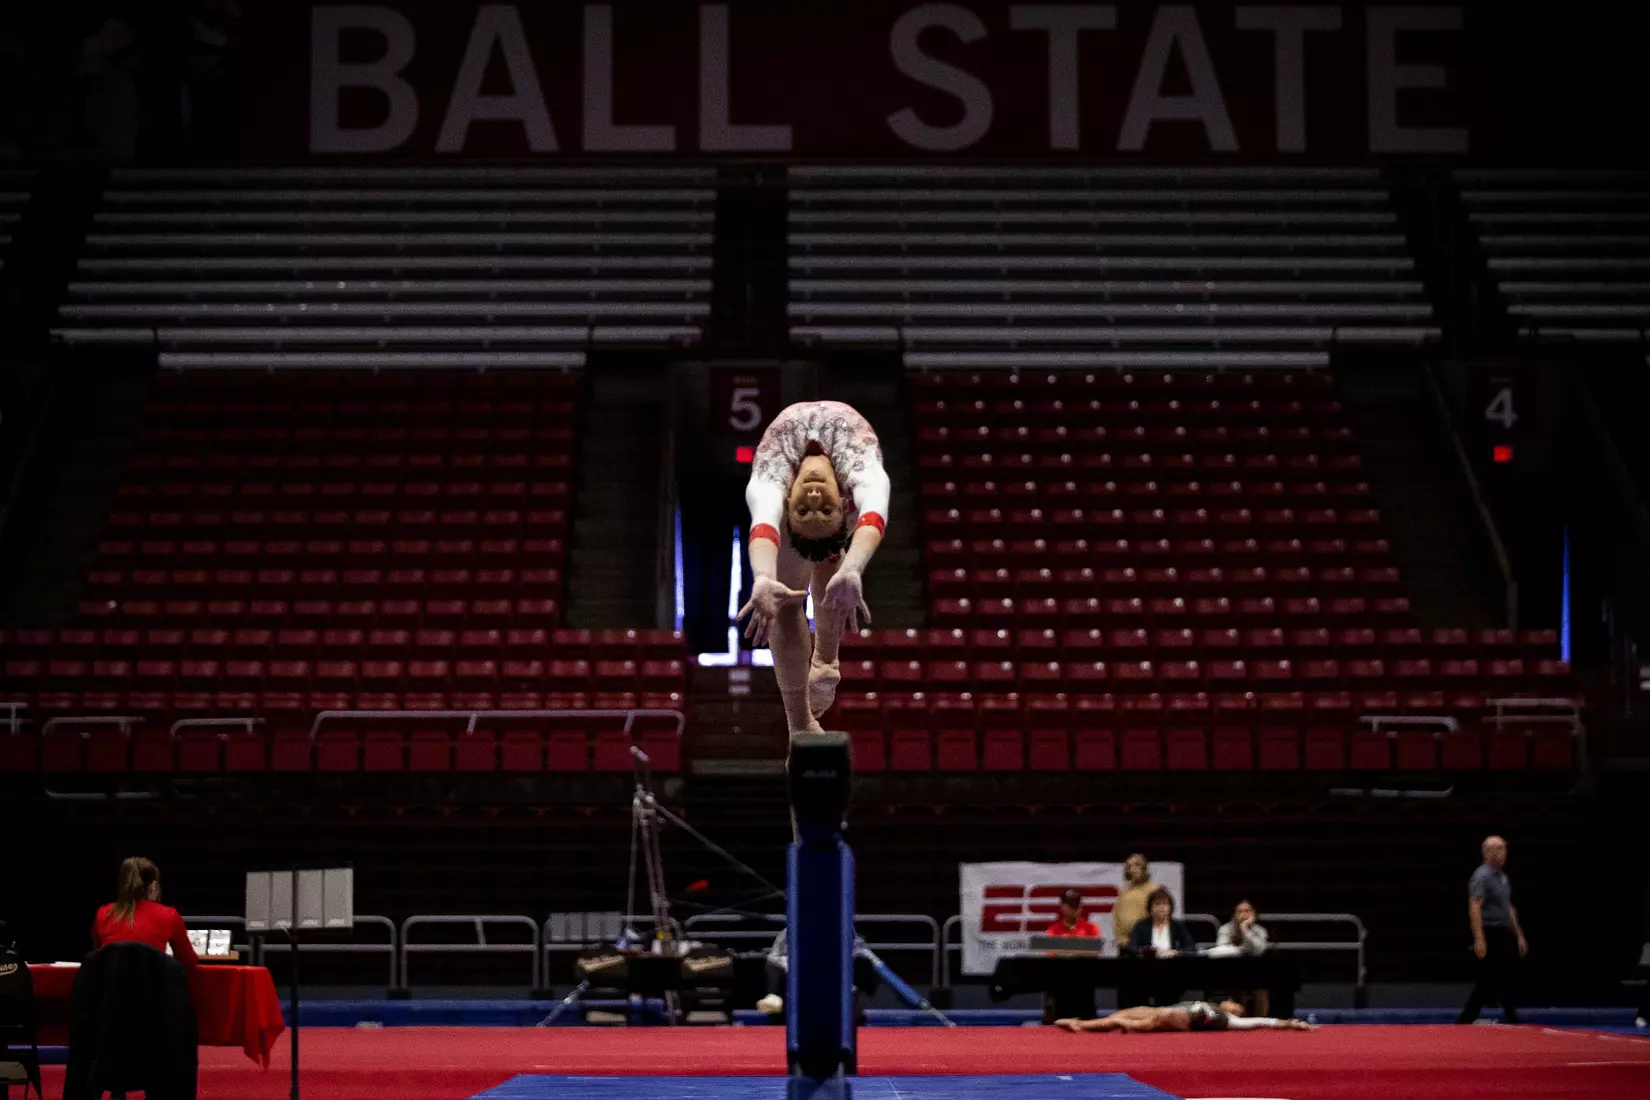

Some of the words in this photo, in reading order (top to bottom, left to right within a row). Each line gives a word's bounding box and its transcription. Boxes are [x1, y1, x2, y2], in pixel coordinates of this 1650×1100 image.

[309, 3, 793, 153] BALL
[884, 1, 1471, 154] STATE
[728, 387, 762, 431] 5
[1484, 386, 1519, 430] 4
[979, 885, 1119, 933] ESP
